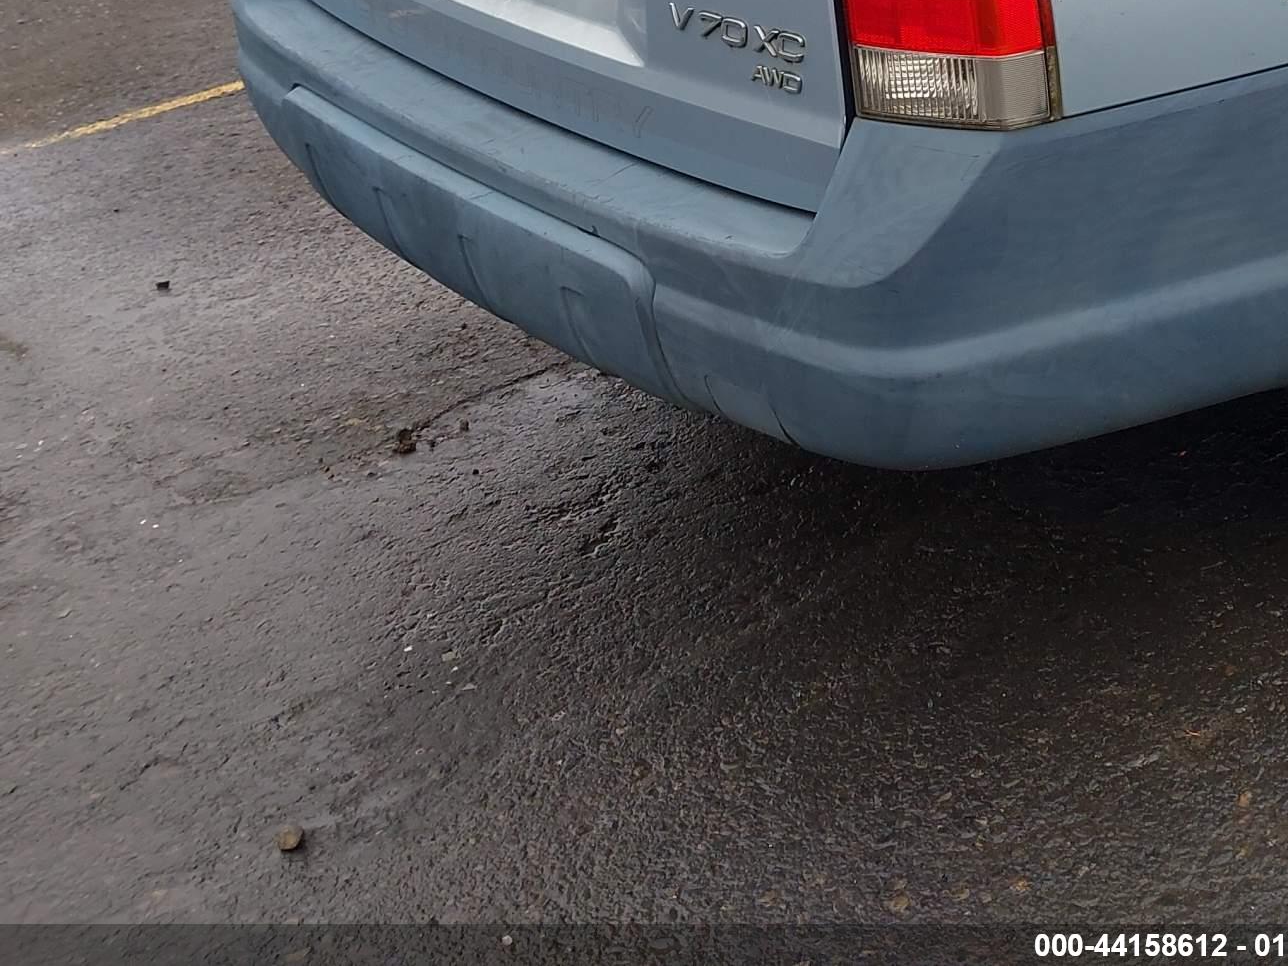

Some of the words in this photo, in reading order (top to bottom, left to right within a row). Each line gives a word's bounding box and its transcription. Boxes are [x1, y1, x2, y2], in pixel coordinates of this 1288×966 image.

[668, 2, 749, 48] V70
[754, 24, 806, 63] XC
[752, 64, 803, 94] AWD
